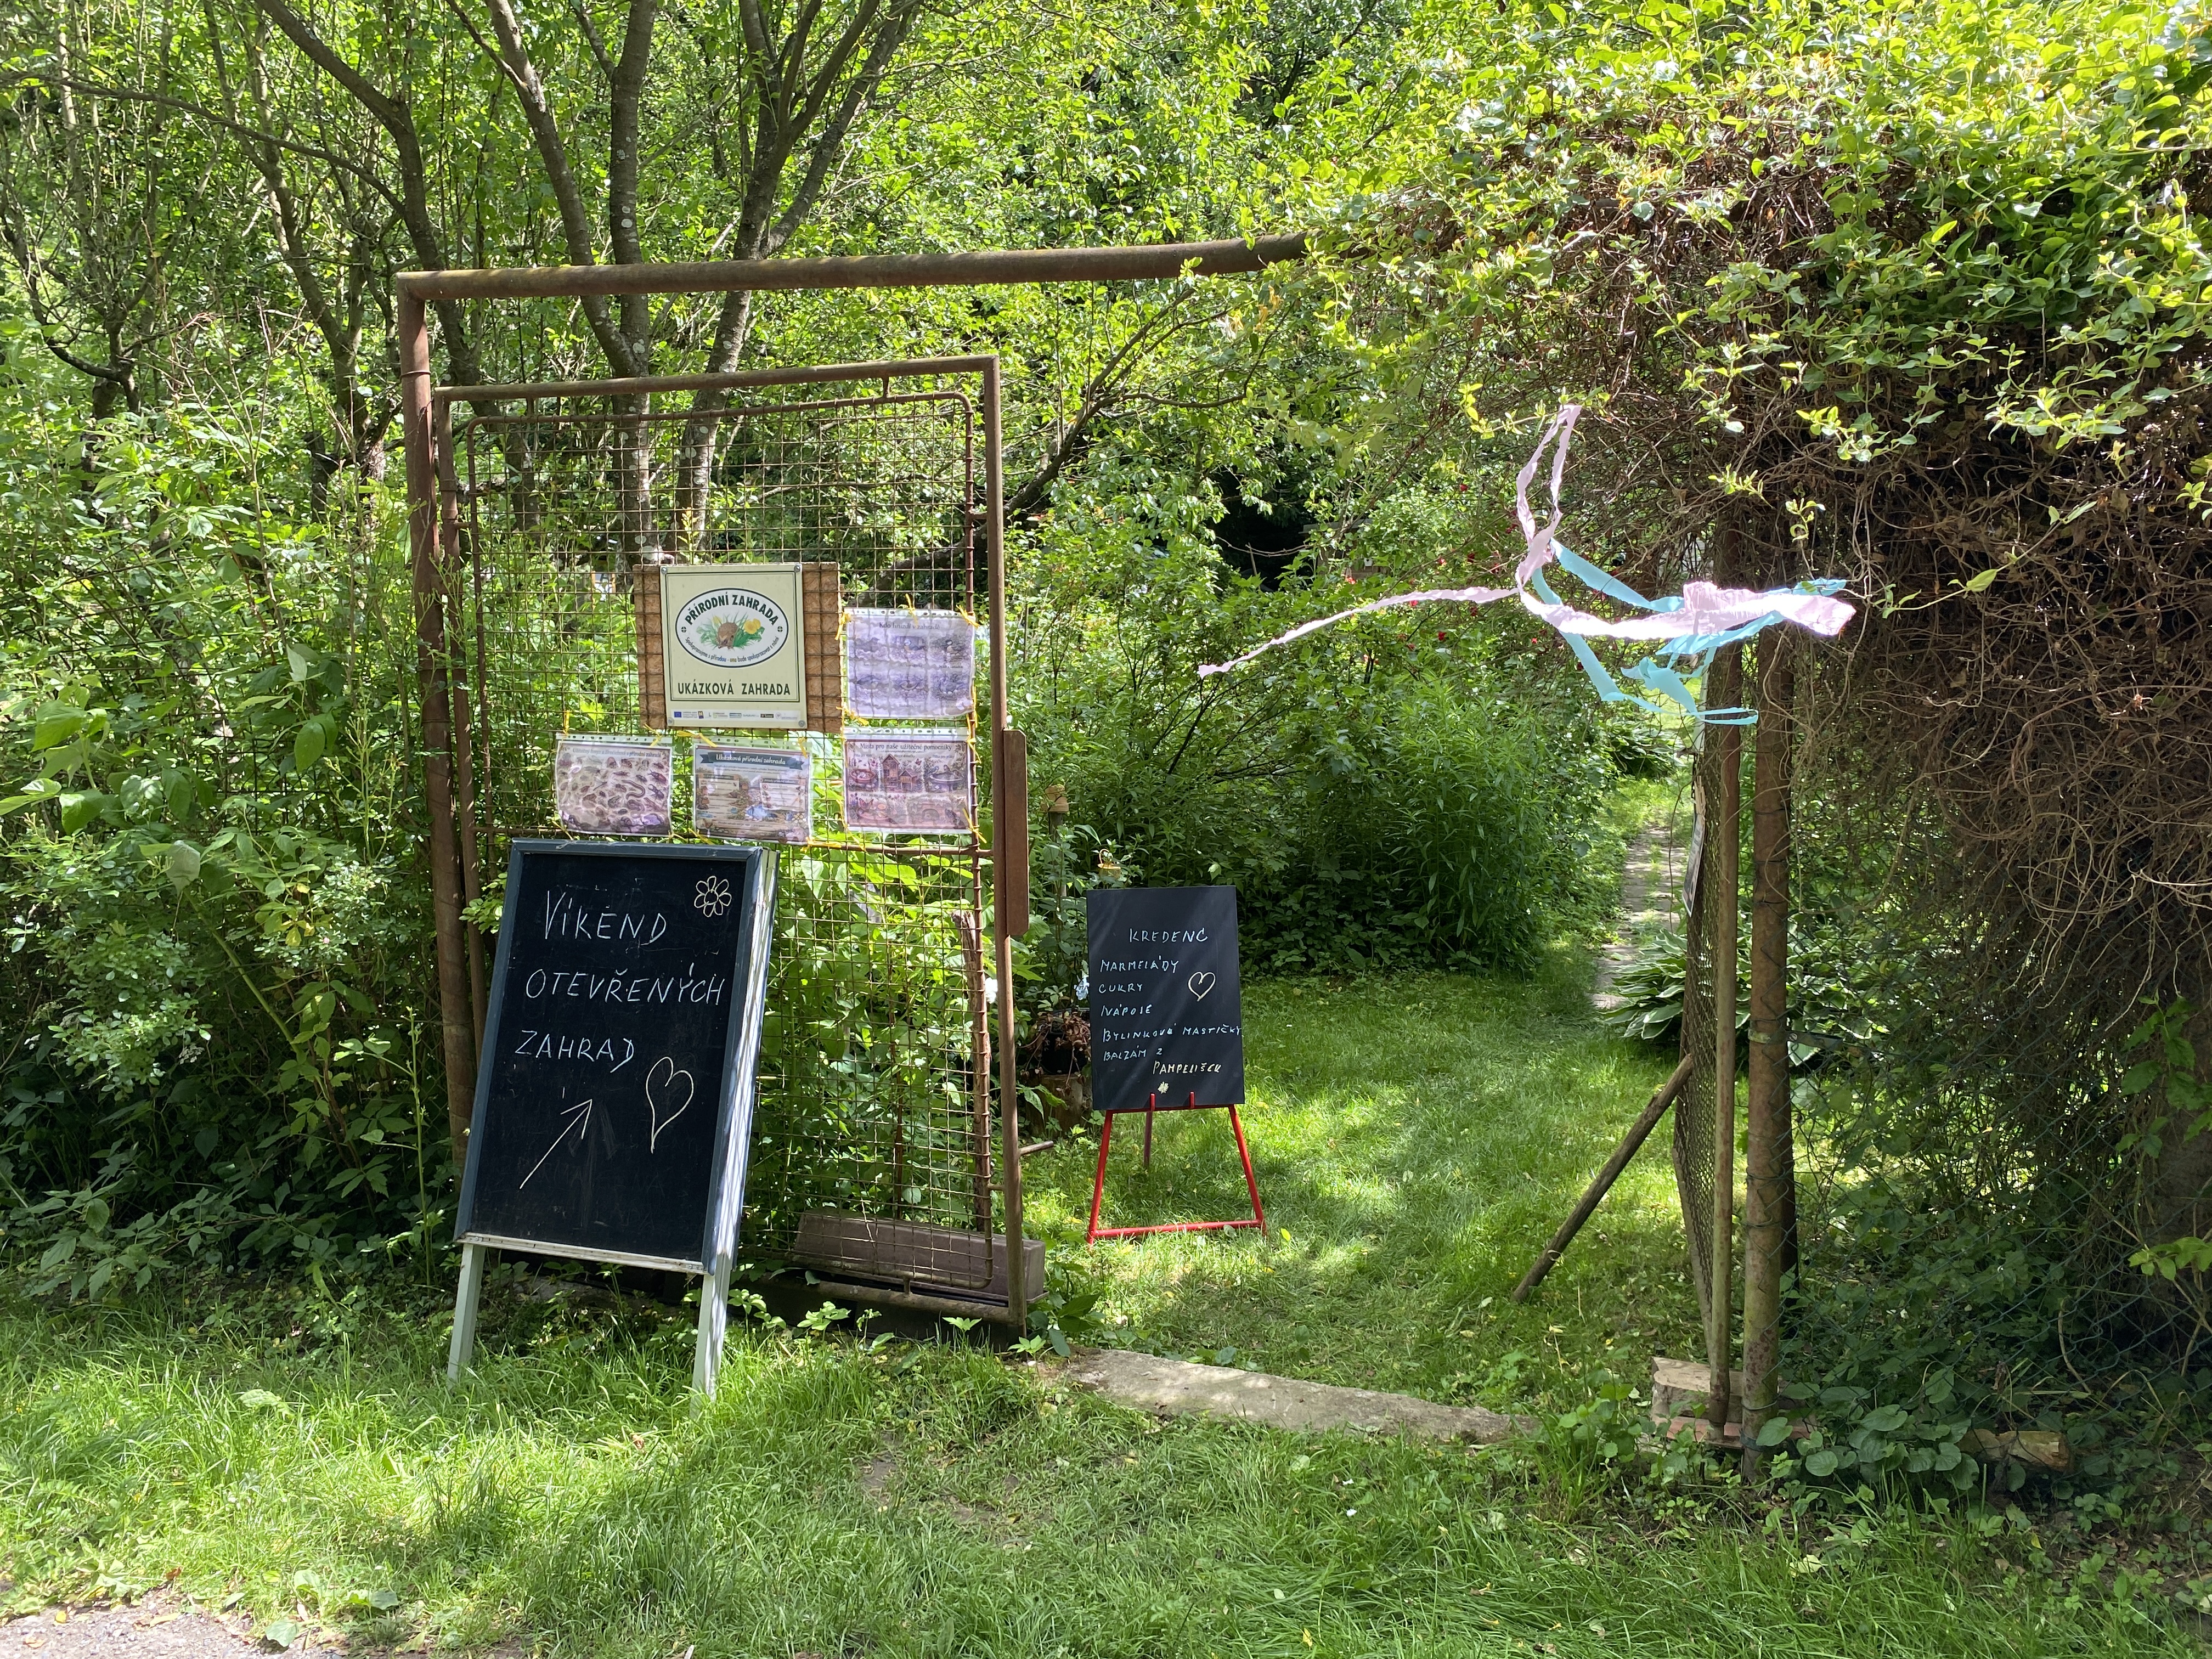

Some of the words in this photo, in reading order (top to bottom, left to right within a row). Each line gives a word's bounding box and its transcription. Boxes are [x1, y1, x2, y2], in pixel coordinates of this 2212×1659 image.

[685, 592, 729, 625] PŘÍRODNÍ
[732, 595, 778, 625] ZAHRADA
[685, 637, 708, 658] Spolupracujme
[678, 679, 734, 695] UKÁZKOVÁ
[741, 683, 791, 695] ZAHRADA
[1129, 928, 1208, 943] KREDENC
[1100, 955, 1178, 973] MARMELÁDY
[526, 962, 725, 1005] OTEVŘENÝCH
[1099, 983, 1143, 993] CUKRY
[1101, 1003, 1152, 1017] NÁPOJE
[1182, 1024, 1242, 1036] MASTIČKY
[515, 1030, 634, 1073] ZAHRAD
[1103, 1045, 1147, 1062] BALZÁM
[1153, 1060, 1222, 1075] PAMPELIŠEK
